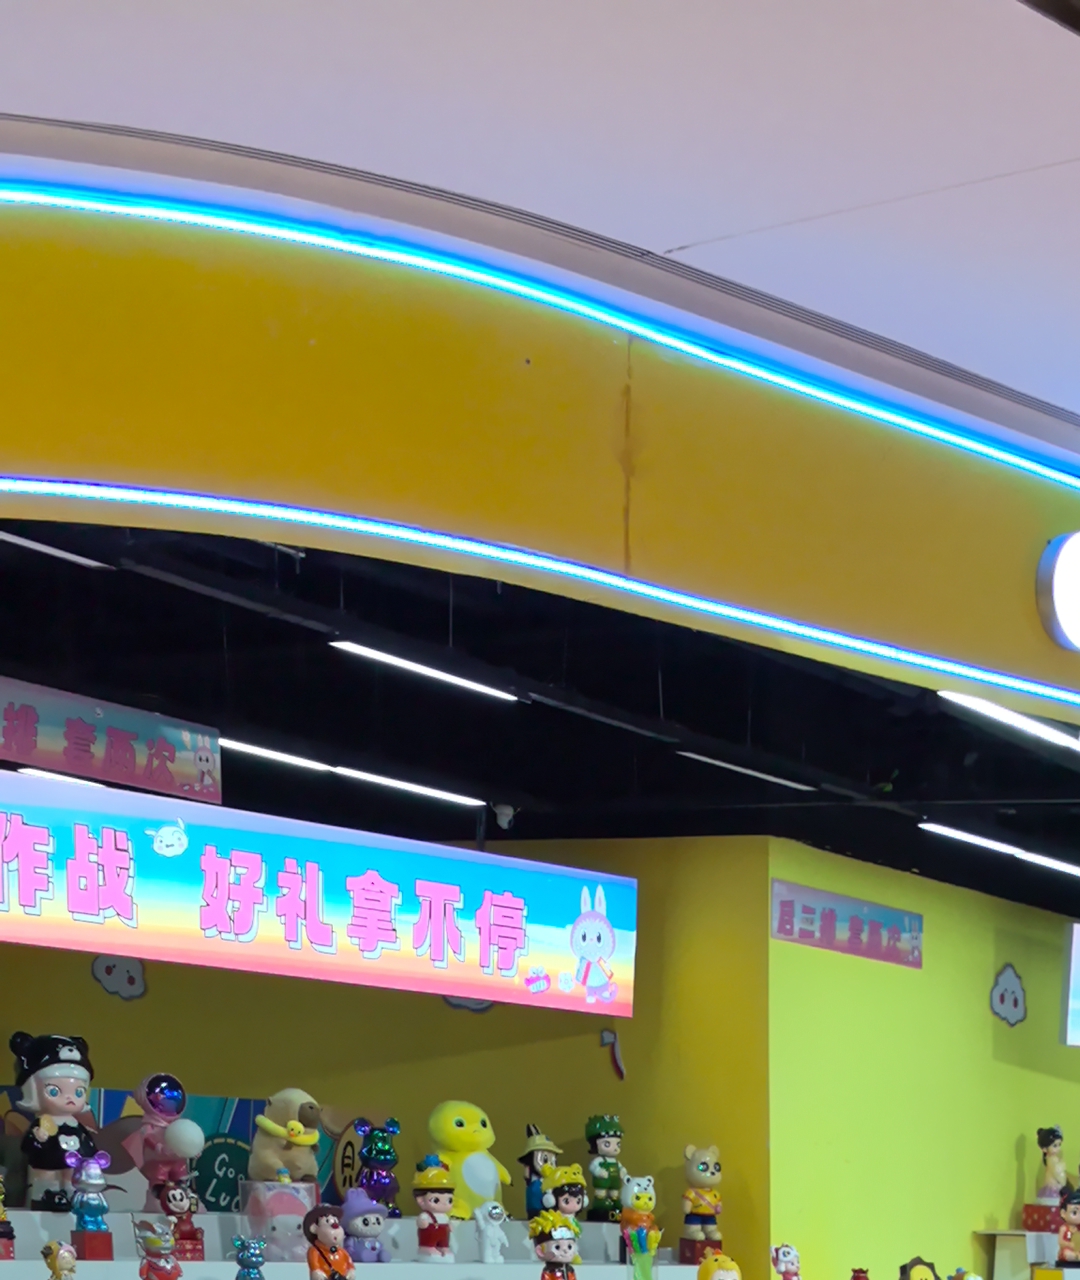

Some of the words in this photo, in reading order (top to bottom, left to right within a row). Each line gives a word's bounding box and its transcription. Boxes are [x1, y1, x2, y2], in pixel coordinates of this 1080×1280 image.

[200, 844, 528, 977] 好礼拿不停
